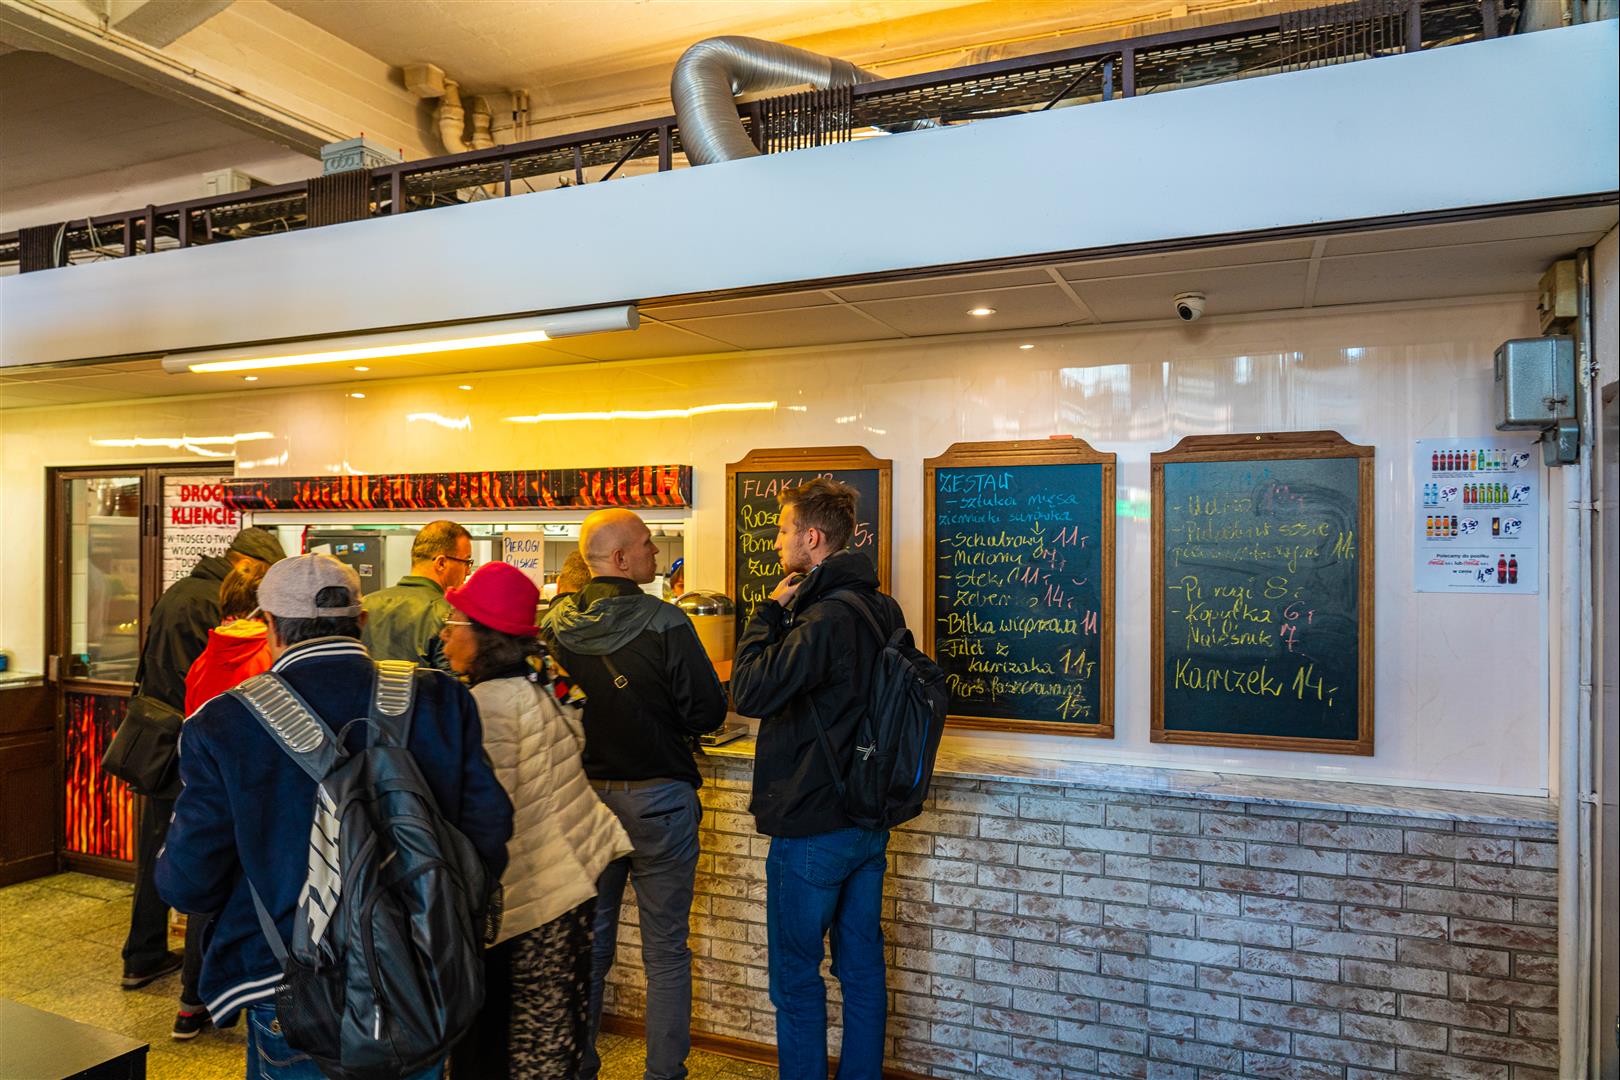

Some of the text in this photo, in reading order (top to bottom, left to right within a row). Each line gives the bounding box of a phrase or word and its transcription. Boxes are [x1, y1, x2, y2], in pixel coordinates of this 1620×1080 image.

[940, 473, 1013, 494] ZESTAW
[181, 484, 223, 502] DROG
[172, 507, 236, 525] KLIENCIE
[206, 534, 212, 544] O
[214, 534, 233, 544] TWO
[504, 537, 540, 553] PIEROGI
[740, 533, 776, 554] Pom
[996, 642, 1009, 656] z
